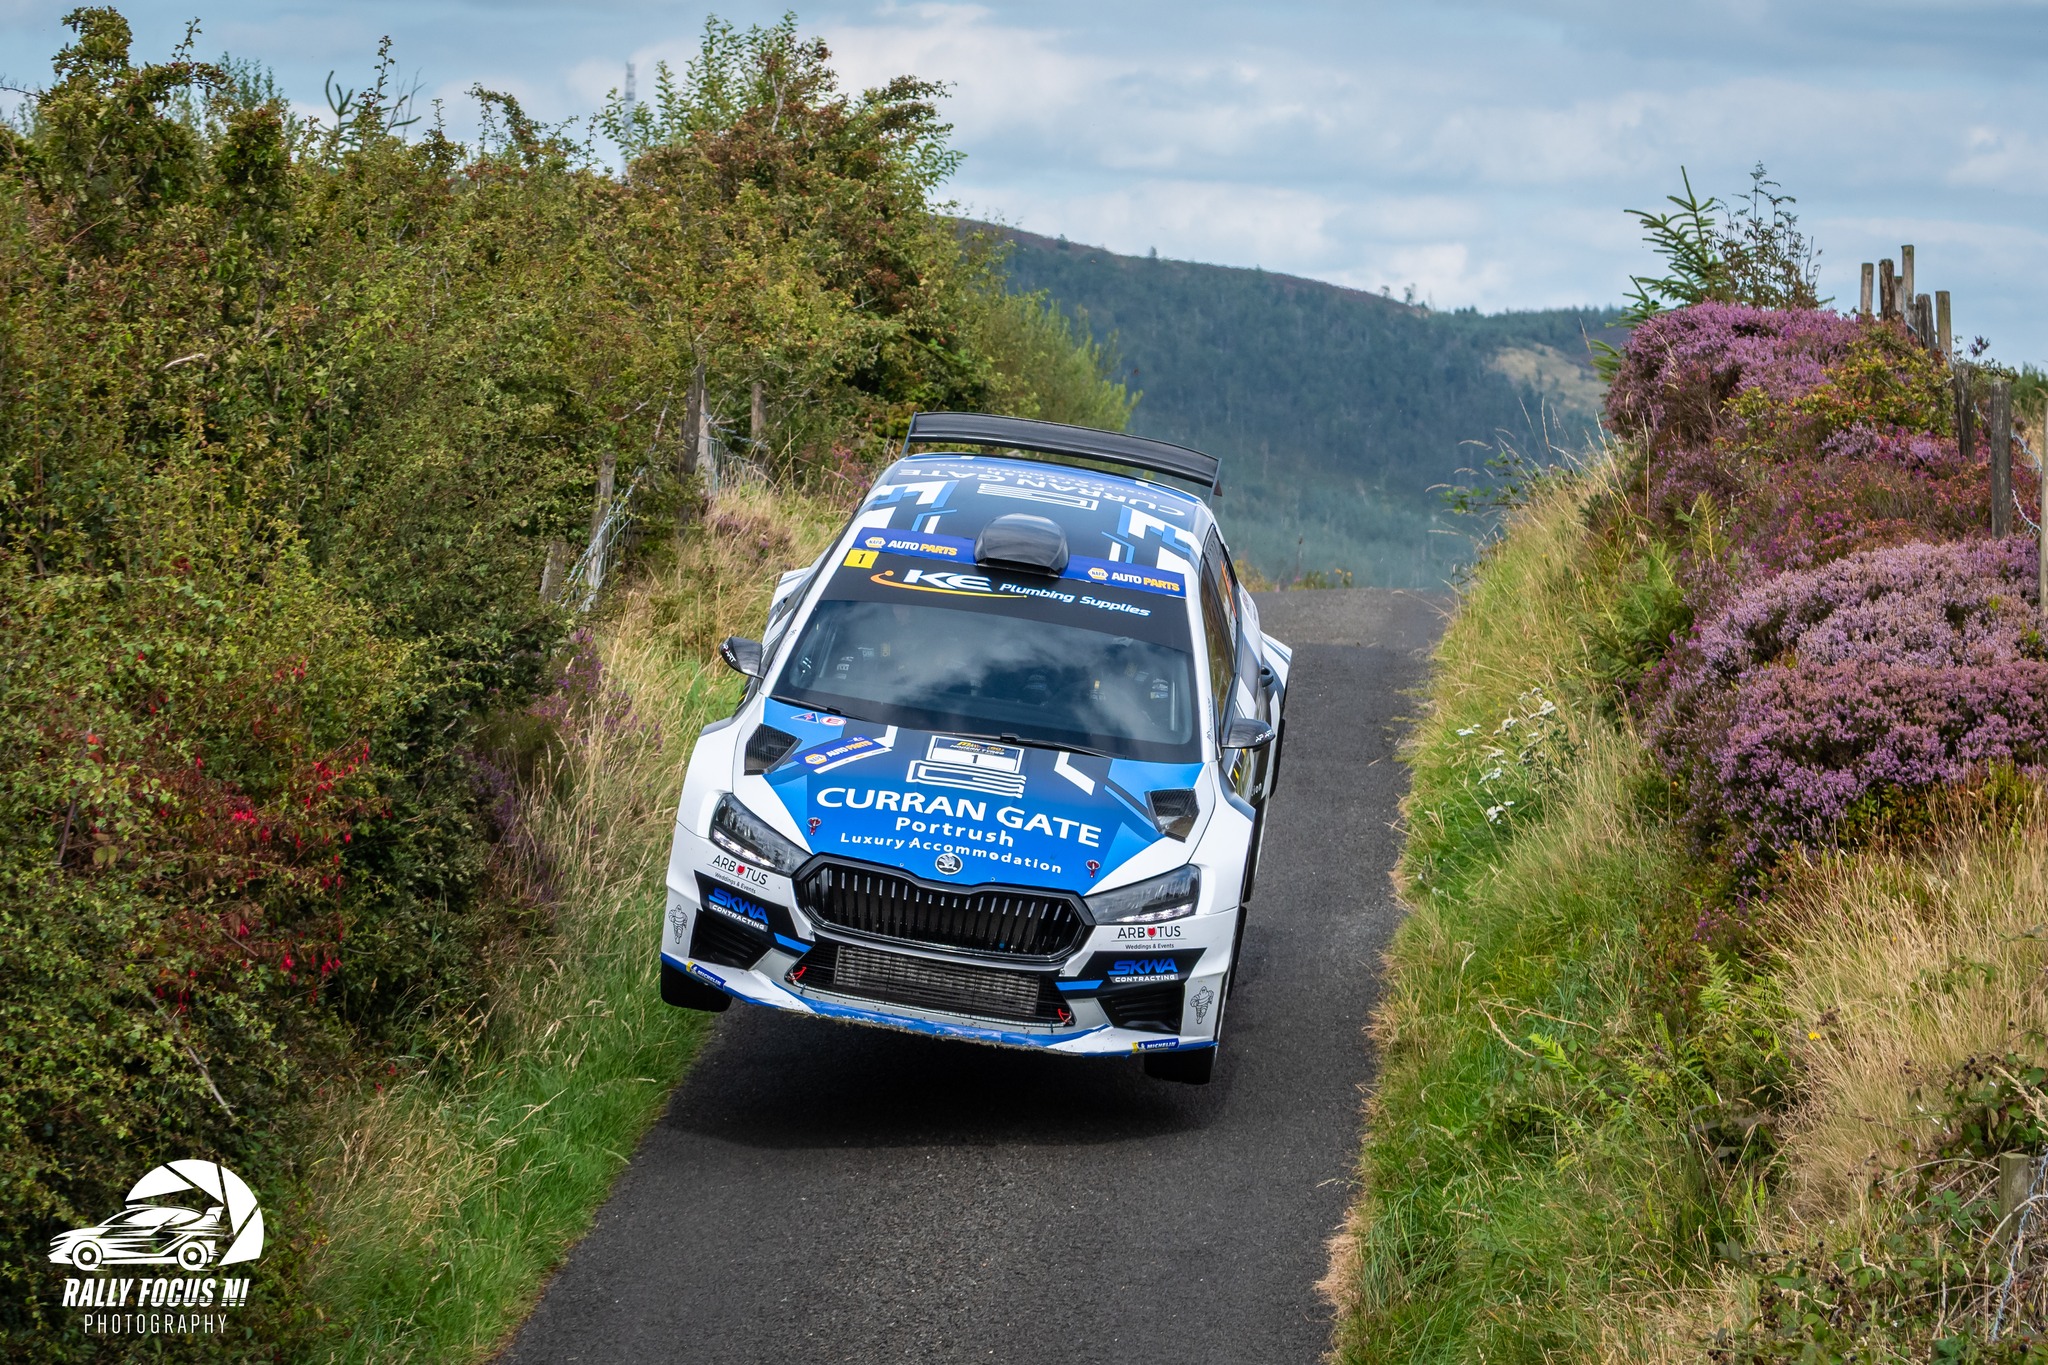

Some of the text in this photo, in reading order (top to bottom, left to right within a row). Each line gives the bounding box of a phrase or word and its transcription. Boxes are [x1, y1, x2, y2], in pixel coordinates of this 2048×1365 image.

[898, 468, 1185, 516] CURRAN GATE
[859, 553, 866, 564] 1
[888, 540, 958, 556] AUTO PARTS
[903, 569, 993, 592] KE
[1111, 572, 1180, 592] AUTO PARTS
[999, 582, 1151, 617] Plumbing Supplies
[826, 746, 849, 758] AUTO
[971, 754, 979, 764] 1
[816, 787, 1102, 848] CURRAN GATE
[895, 816, 1014, 848] Portrush
[840, 832, 1062, 874] Luxury Accommodation
[714, 871, 736, 886] Weddings
[740, 882, 756, 894] Events
[708, 887, 769, 924] SKWA
[712, 904, 765, 931] CONTRACTING
[1125, 943, 1152, 951] Weddings
[1107, 958, 1178, 976] SKWA
[1114, 974, 1176, 983] CONTRACTING
[1146, 1040, 1177, 1049] MICHELIN
